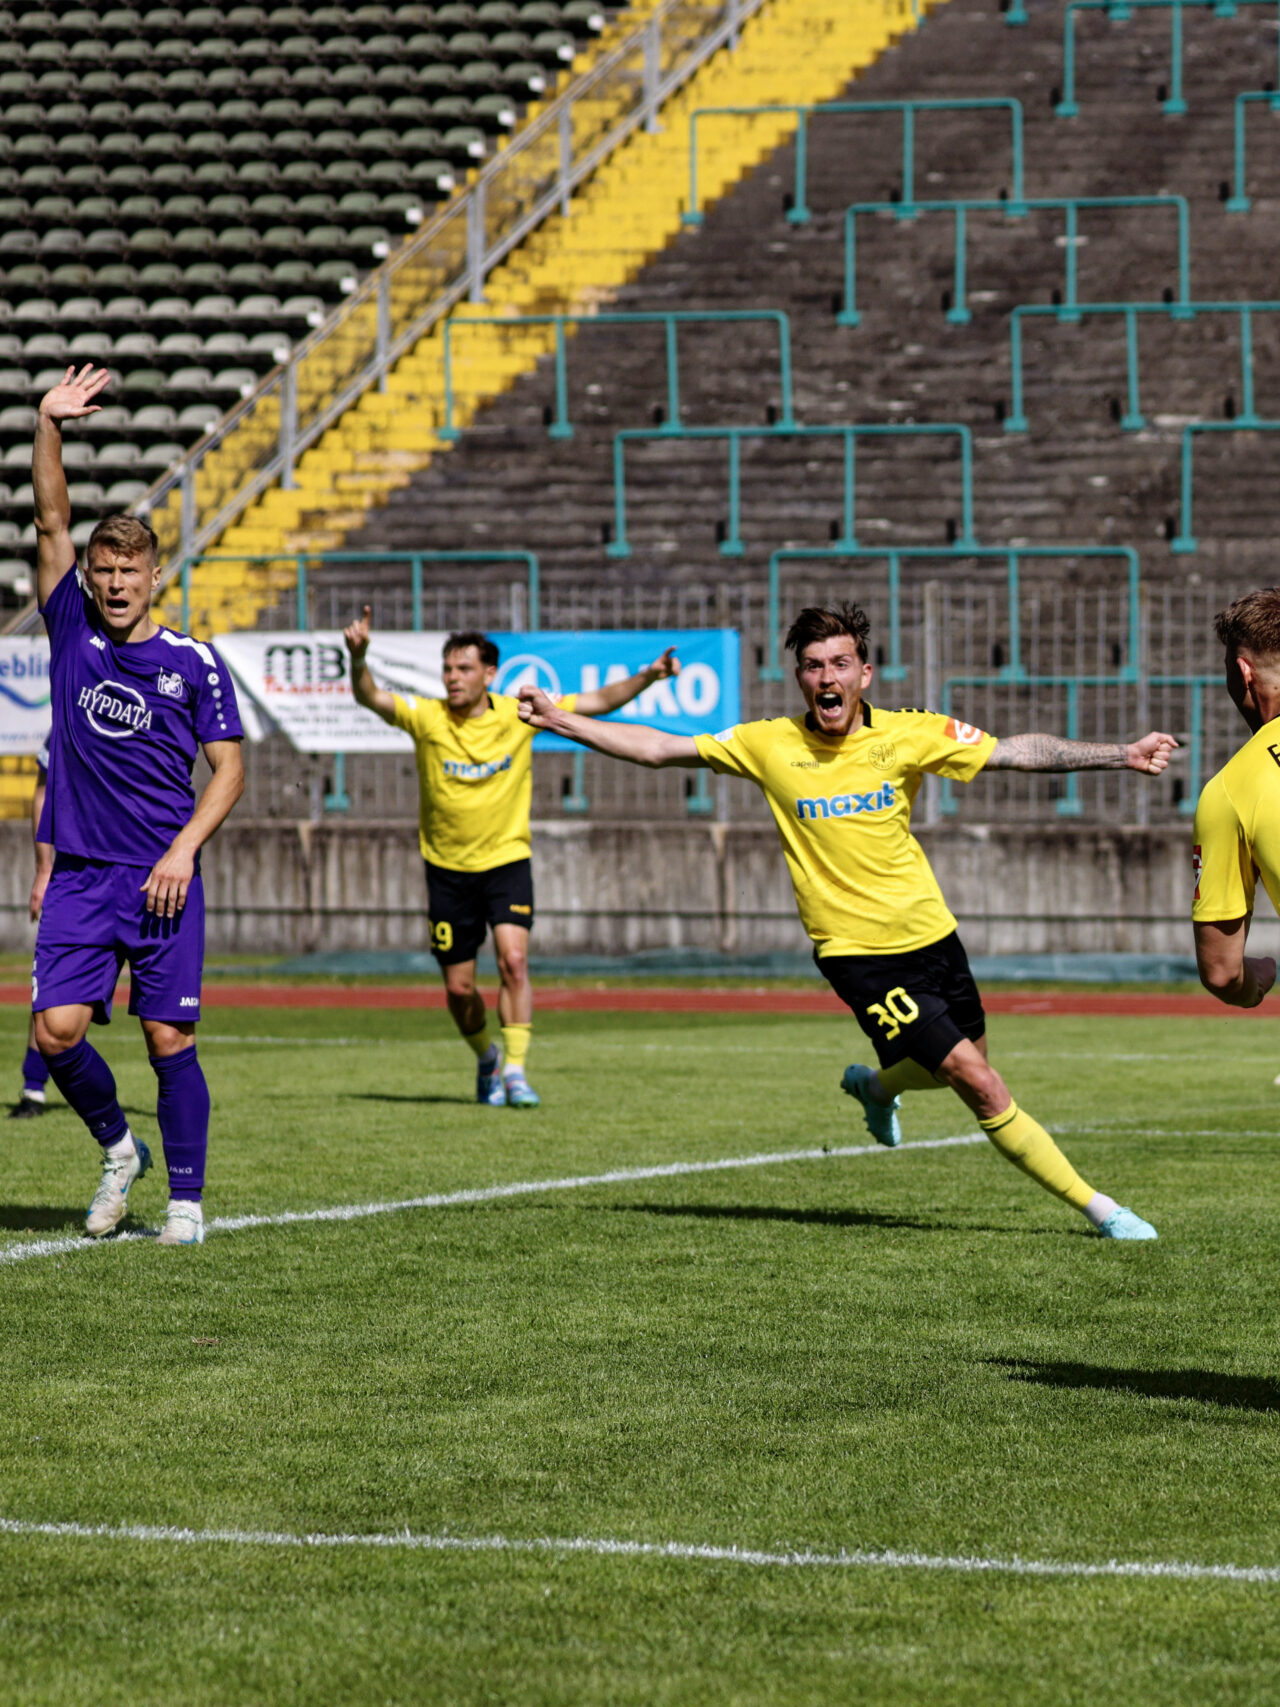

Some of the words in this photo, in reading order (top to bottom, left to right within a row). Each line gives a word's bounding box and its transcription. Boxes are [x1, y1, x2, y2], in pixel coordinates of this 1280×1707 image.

[77, 686, 153, 730] HYPDATA
[796, 781, 896, 819] maxit
[866, 986, 919, 1041] 30
